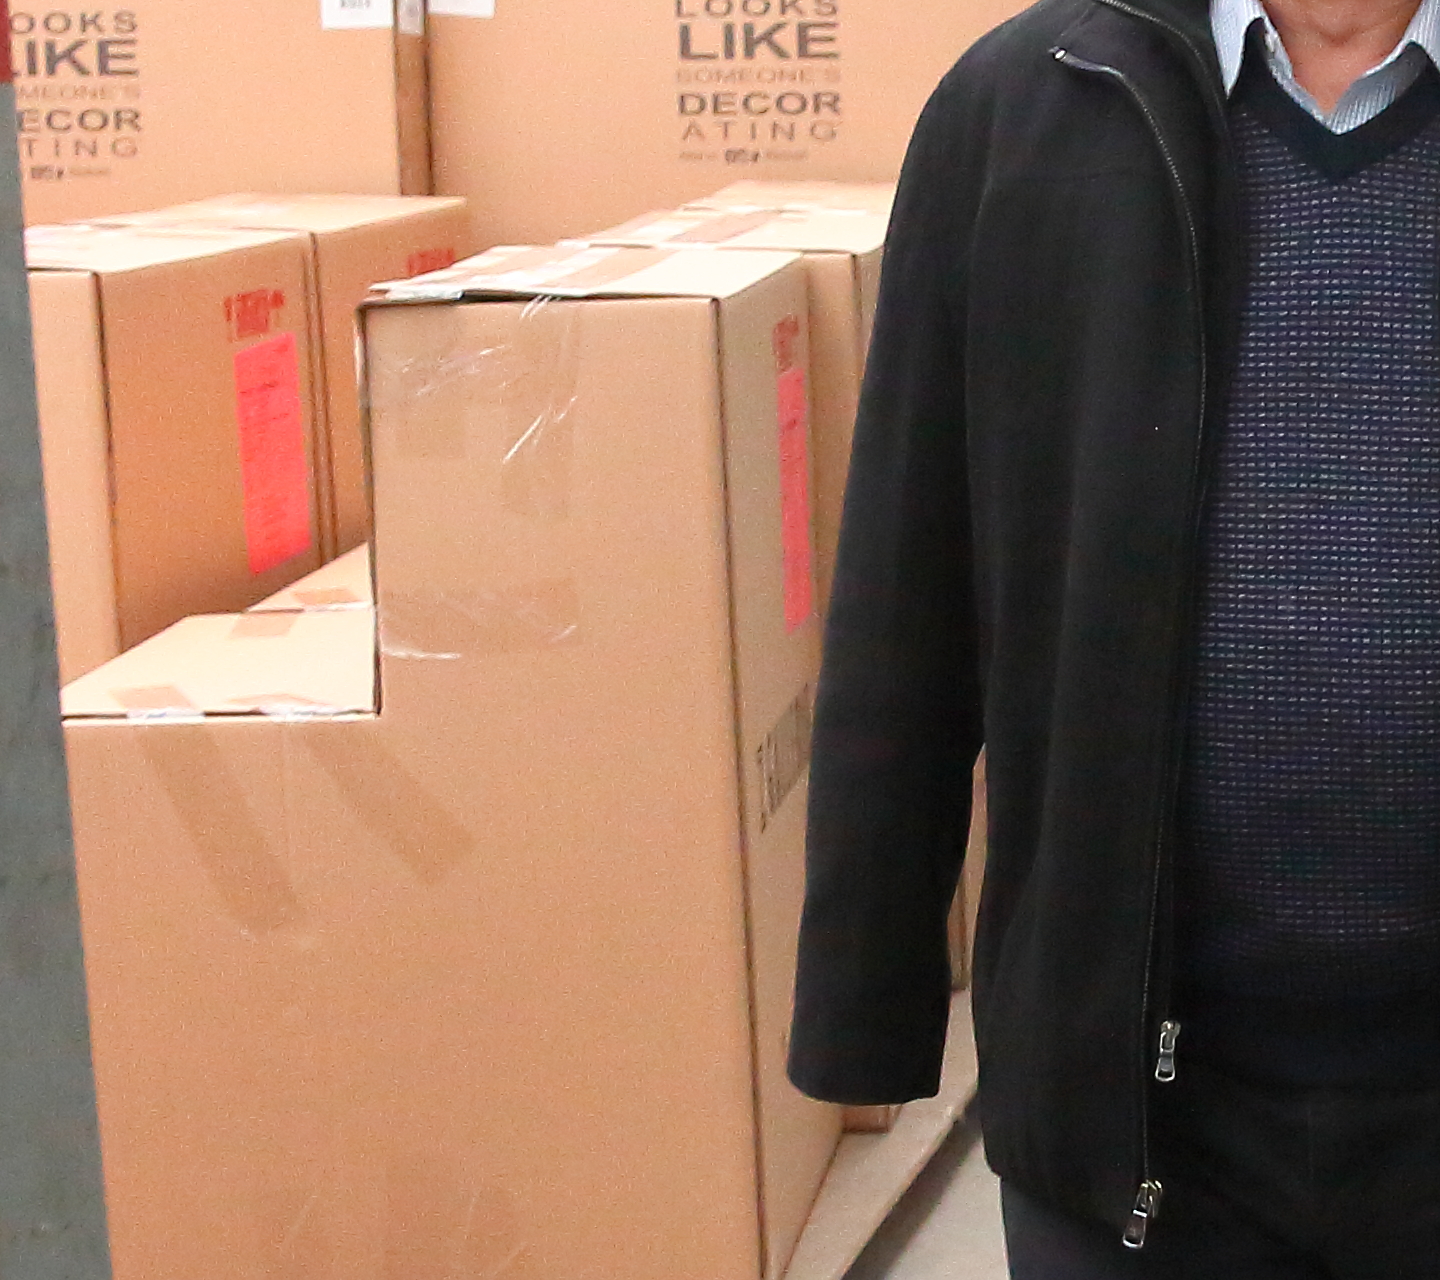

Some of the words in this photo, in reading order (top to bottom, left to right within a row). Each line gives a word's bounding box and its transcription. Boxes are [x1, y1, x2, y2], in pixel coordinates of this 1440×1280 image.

[10, 11, 138, 35] OOKS
[678, 21, 841, 60] LIKE
[12, 38, 140, 77] IKE
[677, 90, 841, 116] DECOR
[16, 107, 143, 133] ECOR
[681, 119, 839, 142] ATING
[26, 136, 138, 159] TING
